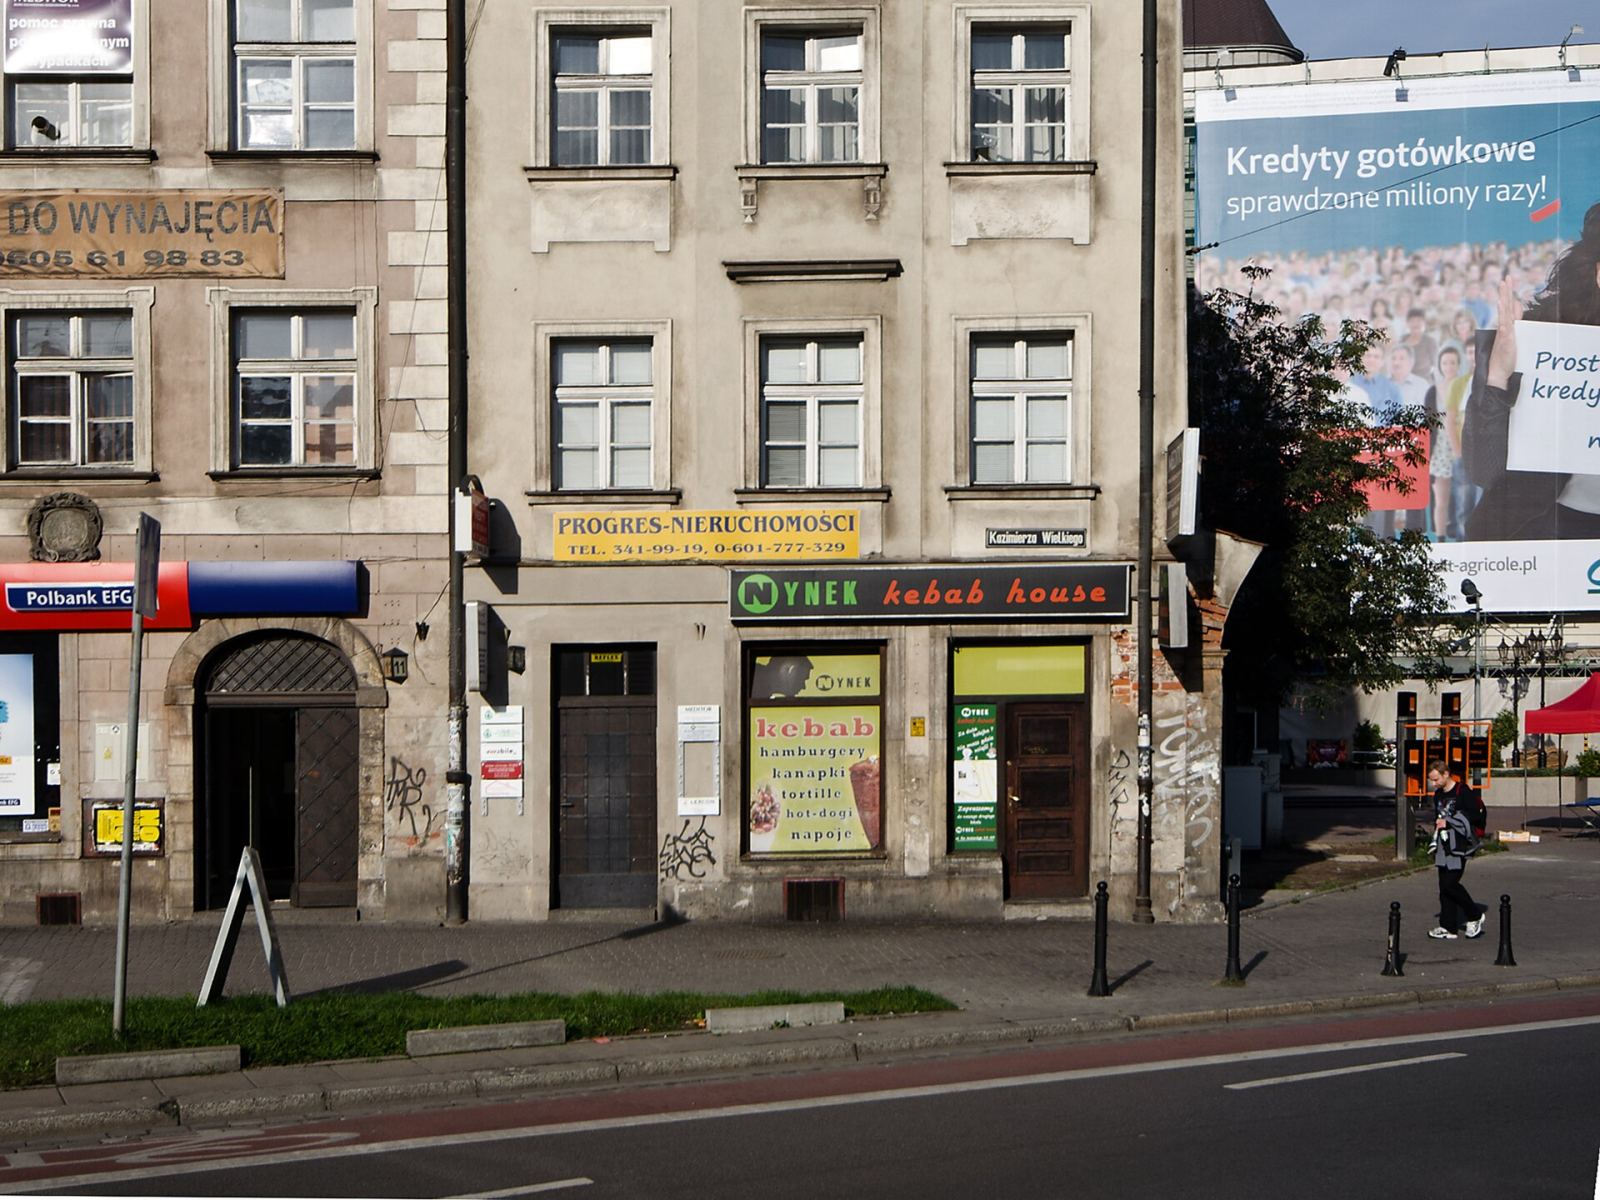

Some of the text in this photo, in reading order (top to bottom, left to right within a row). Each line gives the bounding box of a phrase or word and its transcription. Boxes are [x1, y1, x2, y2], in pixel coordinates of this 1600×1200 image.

[1227, 136, 1536, 180] Kredyty gotówkowe
[1227, 175, 1547, 221] sprawdzone miliony razy!
[8, 201, 274, 242] DO WYNAJĘCIA
[86, 250, 126, 266] 61
[143, 250, 188, 266] 98
[200, 250, 245, 266] 83
[558, 511, 856, 535] PROGRES-NIERUCHOMOŚCI
[989, 531, 1084, 547] Kazimierza Wielkiego
[568, 542, 846, 557] TEL. 341-99-19, 0-601-777-329
[27, 589, 132, 606] Polbank EFG
[883, 578, 984, 606] kebab
[1006, 577, 1106, 604] house
[756, 717, 875, 739] kebab
[760, 746, 865, 759] hamburgery
[773, 767, 845, 781] kanapki
[782, 788, 842, 800] tortille
[786, 807, 853, 820] hot-dogi
[791, 829, 852, 842] napoje
